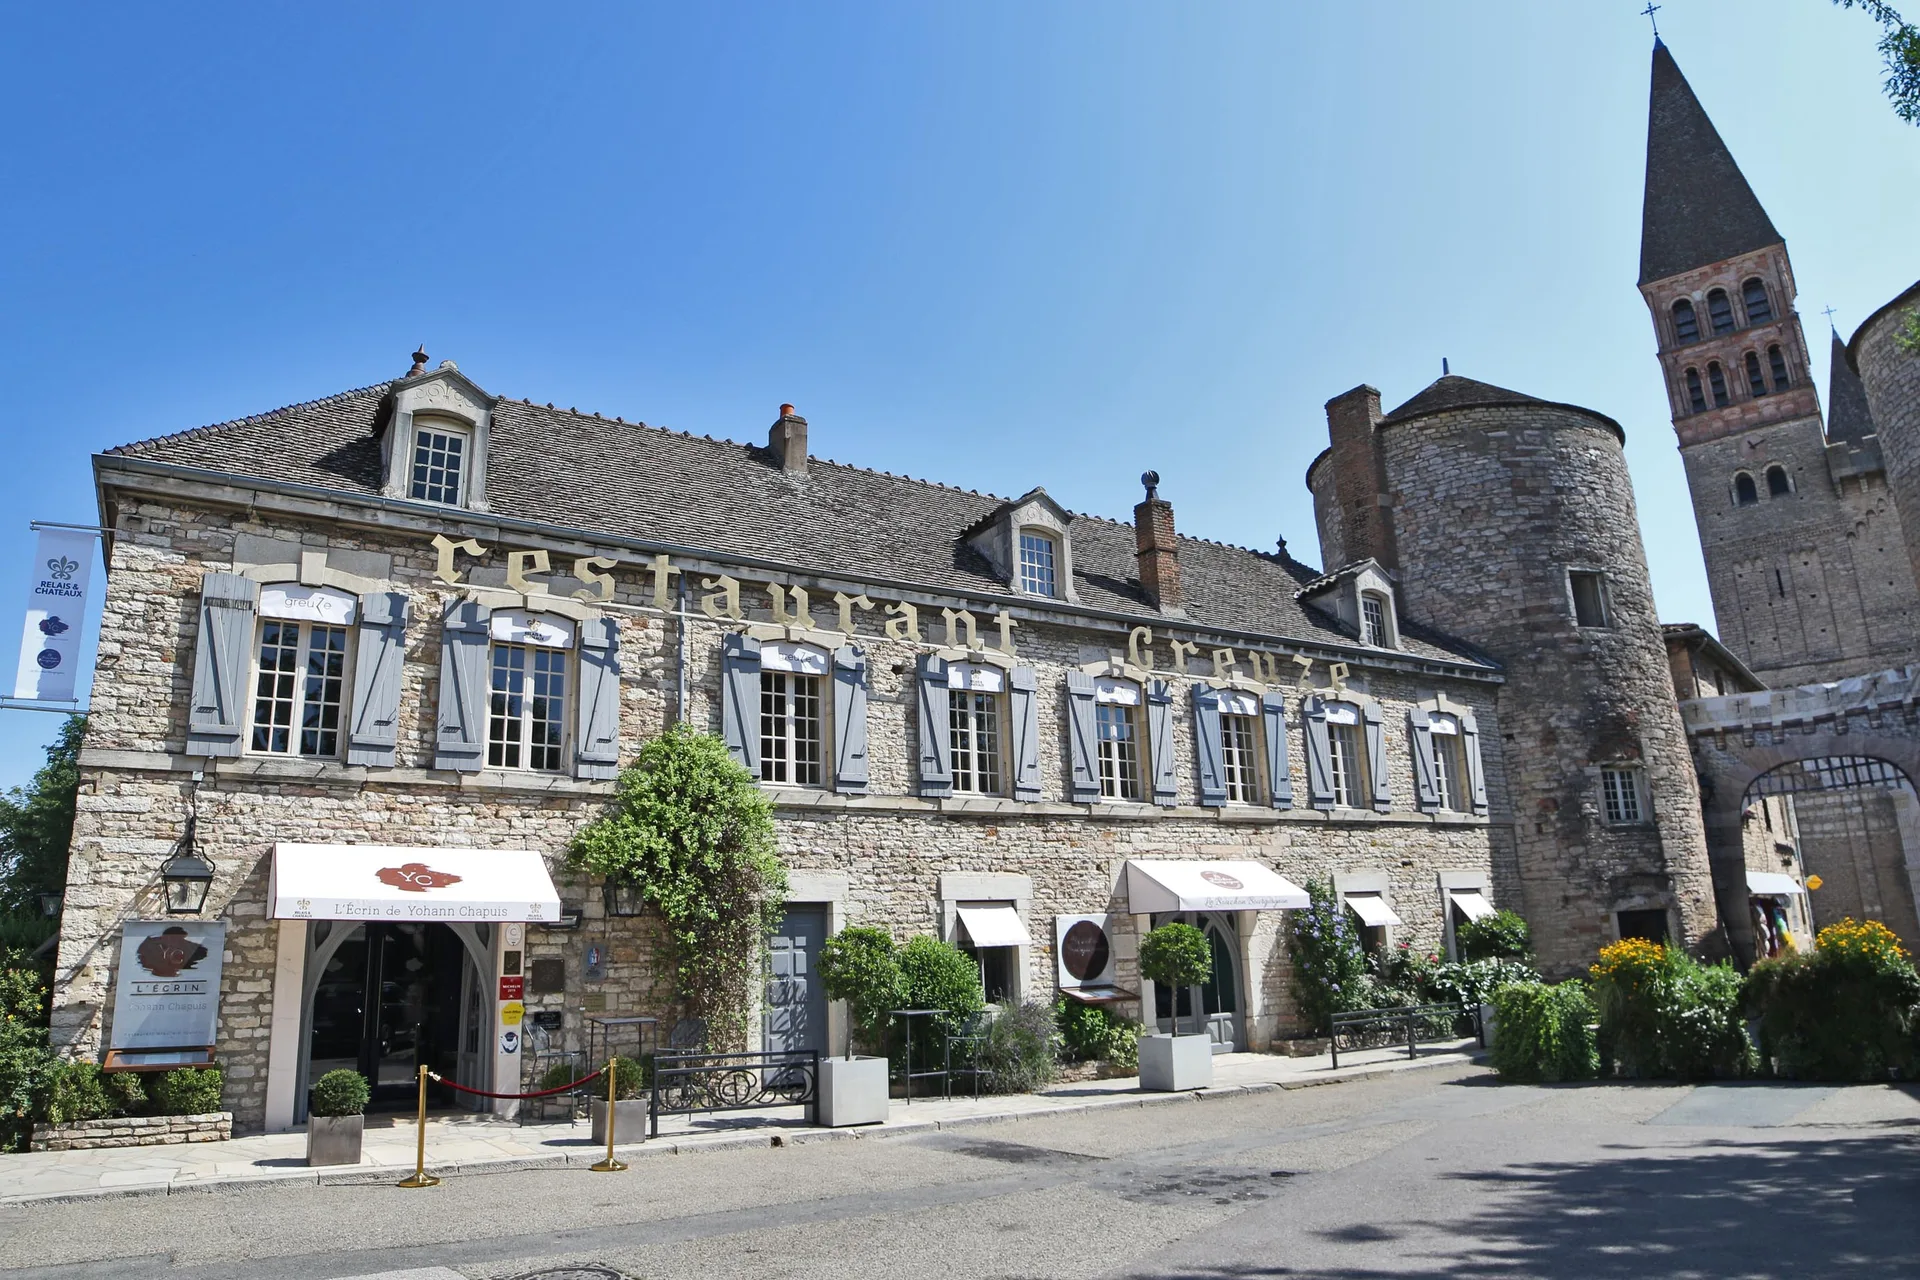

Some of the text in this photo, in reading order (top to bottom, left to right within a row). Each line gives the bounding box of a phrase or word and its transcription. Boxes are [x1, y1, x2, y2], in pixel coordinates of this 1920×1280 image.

[40, 581, 71, 589] RELAIS
[35, 587, 82, 597] CHATEAUX
[430, 533, 1350, 693] restaurant Greuze
[397, 871, 433, 886] YC
[334, 902, 508, 918] L'Écrin de Yohann Chapuis
[167, 1002, 207, 1012] Chapuis
